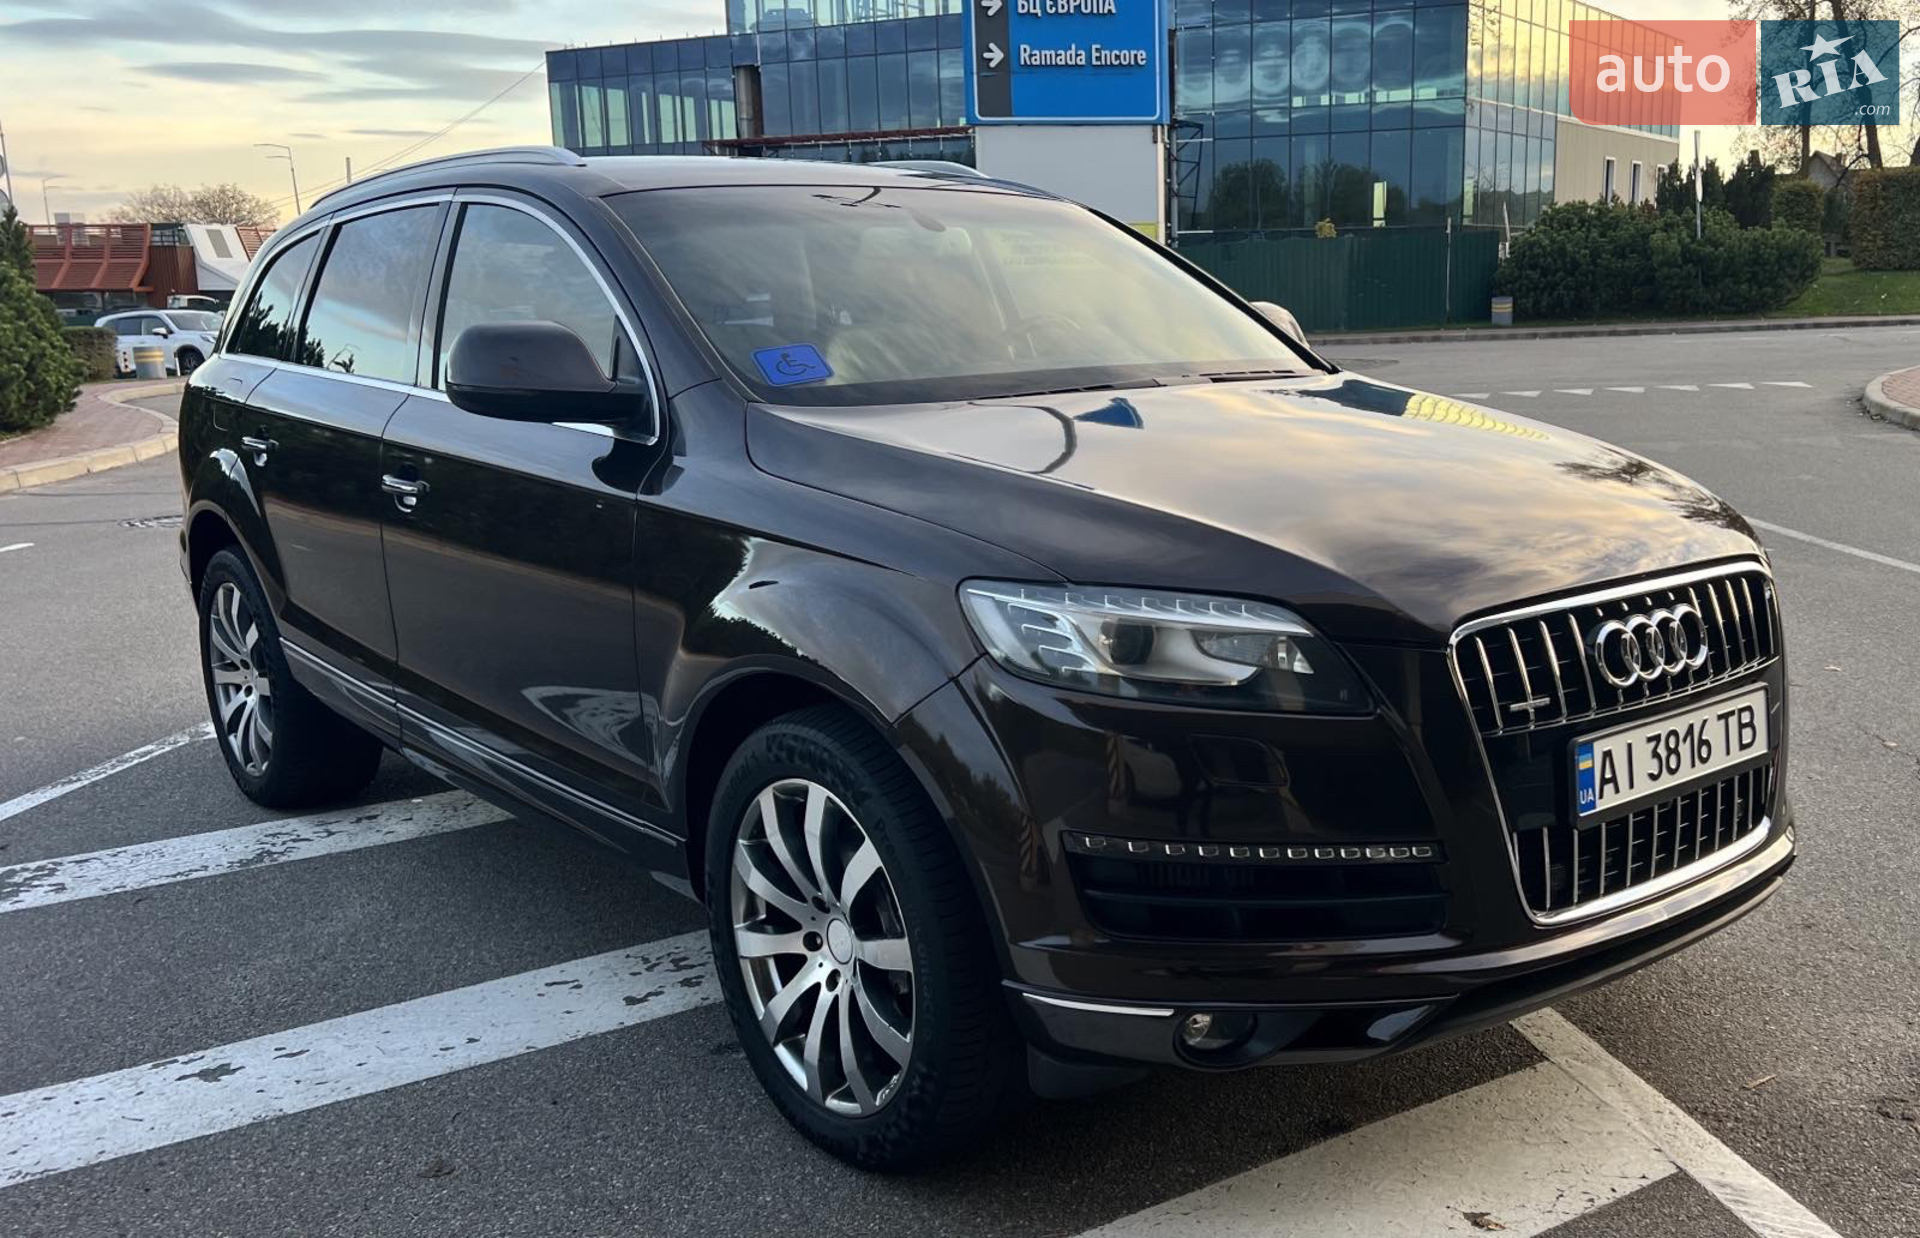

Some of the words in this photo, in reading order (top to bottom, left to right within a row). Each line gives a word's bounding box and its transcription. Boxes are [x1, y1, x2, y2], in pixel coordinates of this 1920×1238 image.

[1019, 43, 1086, 66] Ramada
[1091, 44, 1147, 66] Encore
[1598, 740, 1635, 801] AI
[1646, 716, 1712, 782] 3816
[1717, 704, 1757, 757] TB
[1579, 787, 1595, 805] UA
